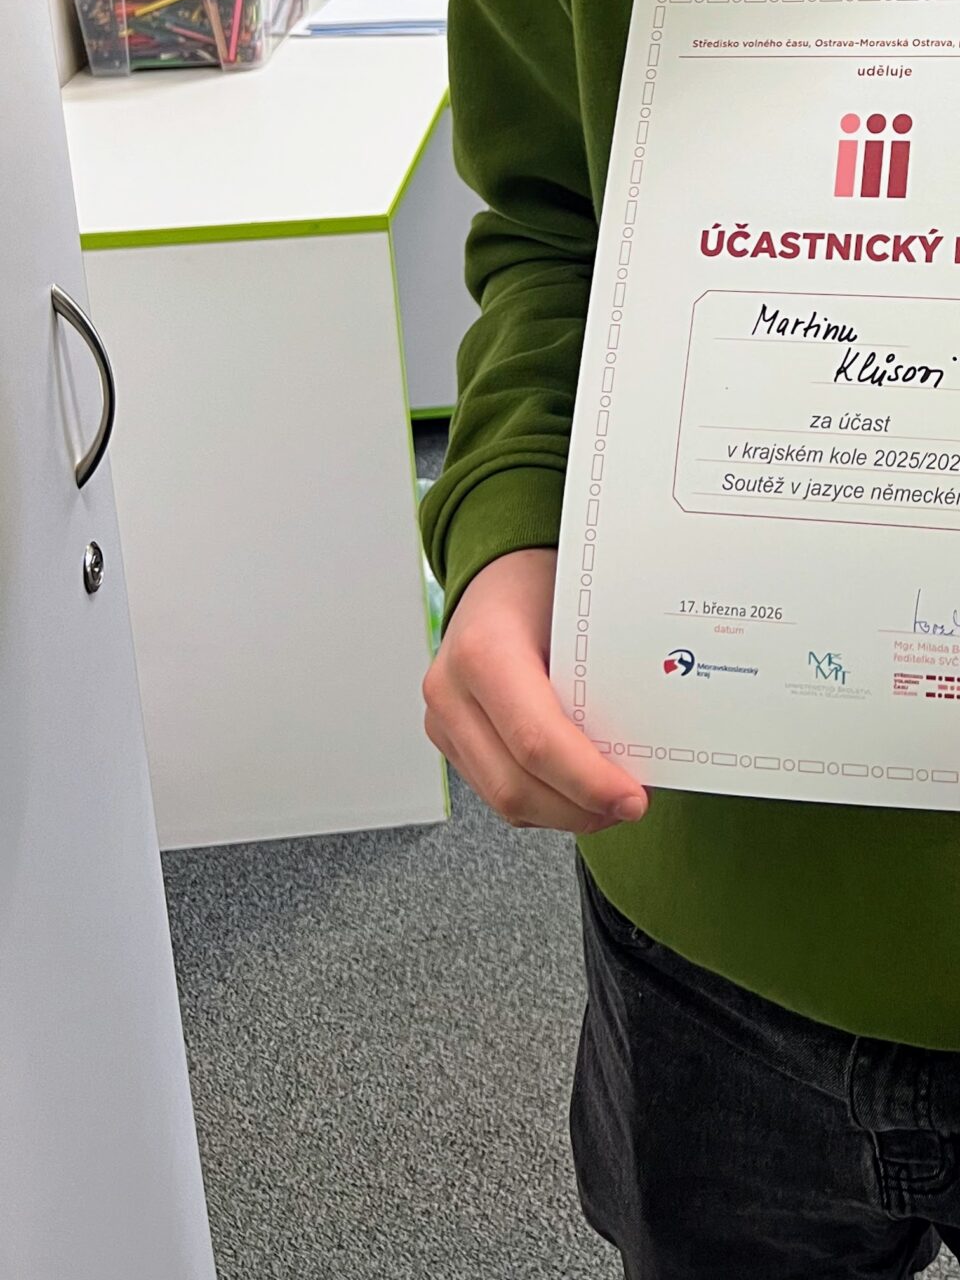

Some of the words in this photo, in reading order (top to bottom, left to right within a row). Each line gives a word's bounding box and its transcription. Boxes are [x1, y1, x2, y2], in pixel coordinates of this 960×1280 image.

[693, 38, 739, 48] Středisko
[743, 38, 783, 48] volného
[785, 38, 811, 49] času,
[815, 37, 908, 48] Ostrava-Moravská
[912, 38, 955, 49] Ostrava,
[857, 64, 912, 78] uděluje
[700, 222, 945, 263] ÚČASTNICKÝ
[751, 303, 858, 343] Martinu
[809, 415, 832, 430] za
[839, 412, 891, 433] účast
[727, 445, 738, 459] v
[742, 442, 823, 464] krajském
[829, 447, 868, 467] kole
[721, 473, 785, 495] Soutěž
[790, 481, 802, 495] v
[803, 479, 865, 502] jazyce
[680, 600, 699, 614] 17.
[703, 601, 747, 618] března
[750, 605, 783, 620] 2026
[714, 624, 745, 635] datum
[893, 640, 914, 651] Mgr.
[917, 642, 949, 654] Milada
